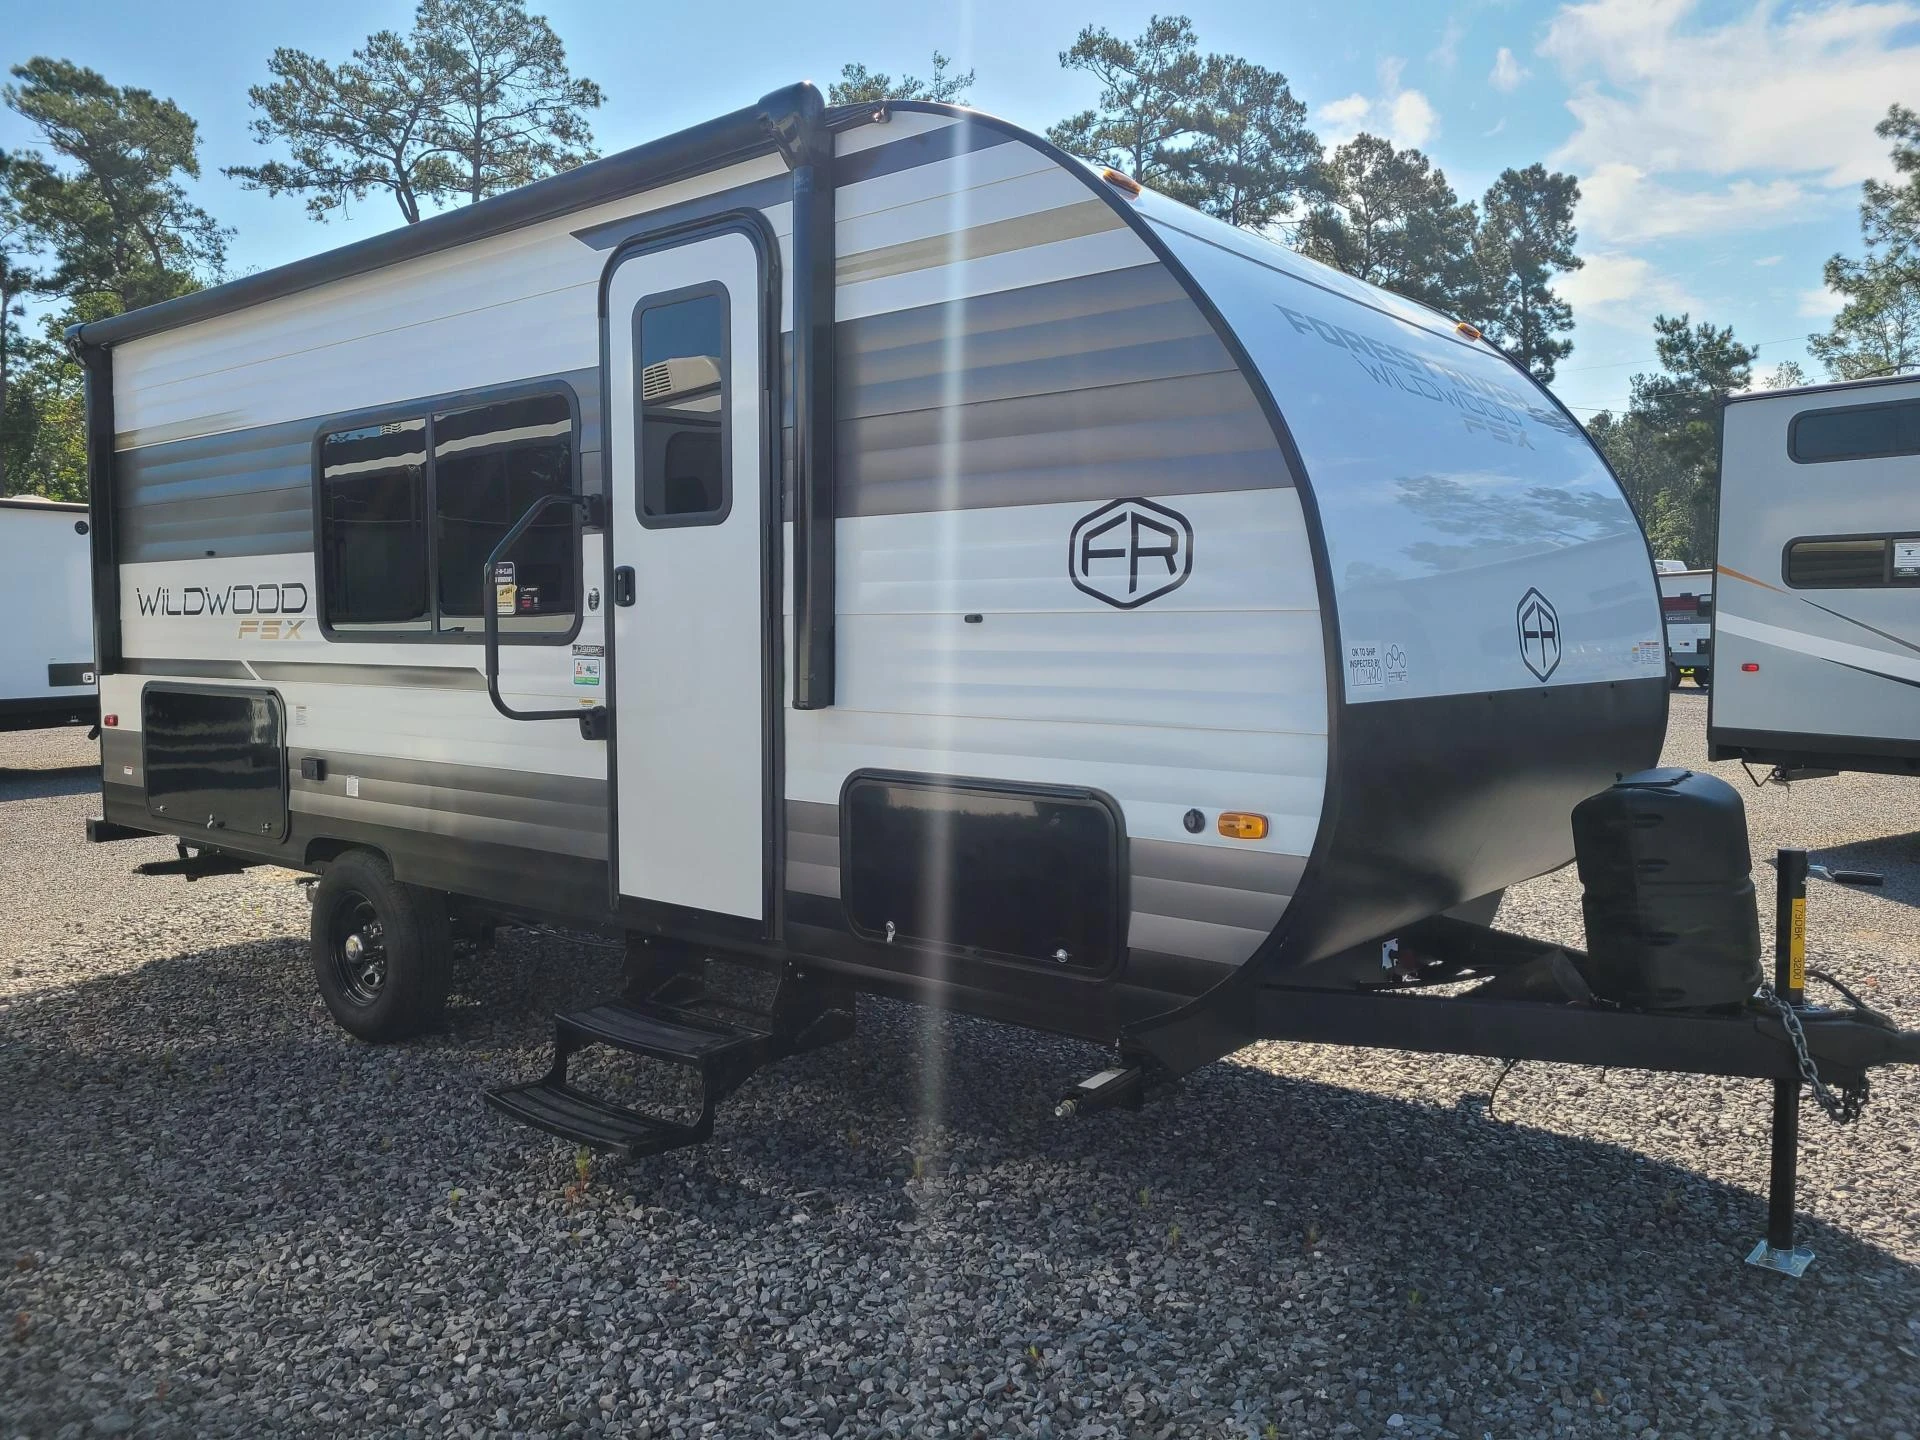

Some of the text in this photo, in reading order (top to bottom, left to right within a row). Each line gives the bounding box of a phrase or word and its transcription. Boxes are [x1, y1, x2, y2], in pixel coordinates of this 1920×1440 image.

[1273, 303, 1438, 379] FOREST
[1351, 352, 1522, 427] WILDWOOD
[237, 619, 306, 640] FSX
[1793, 904, 1803, 980] 179DBK 3200
